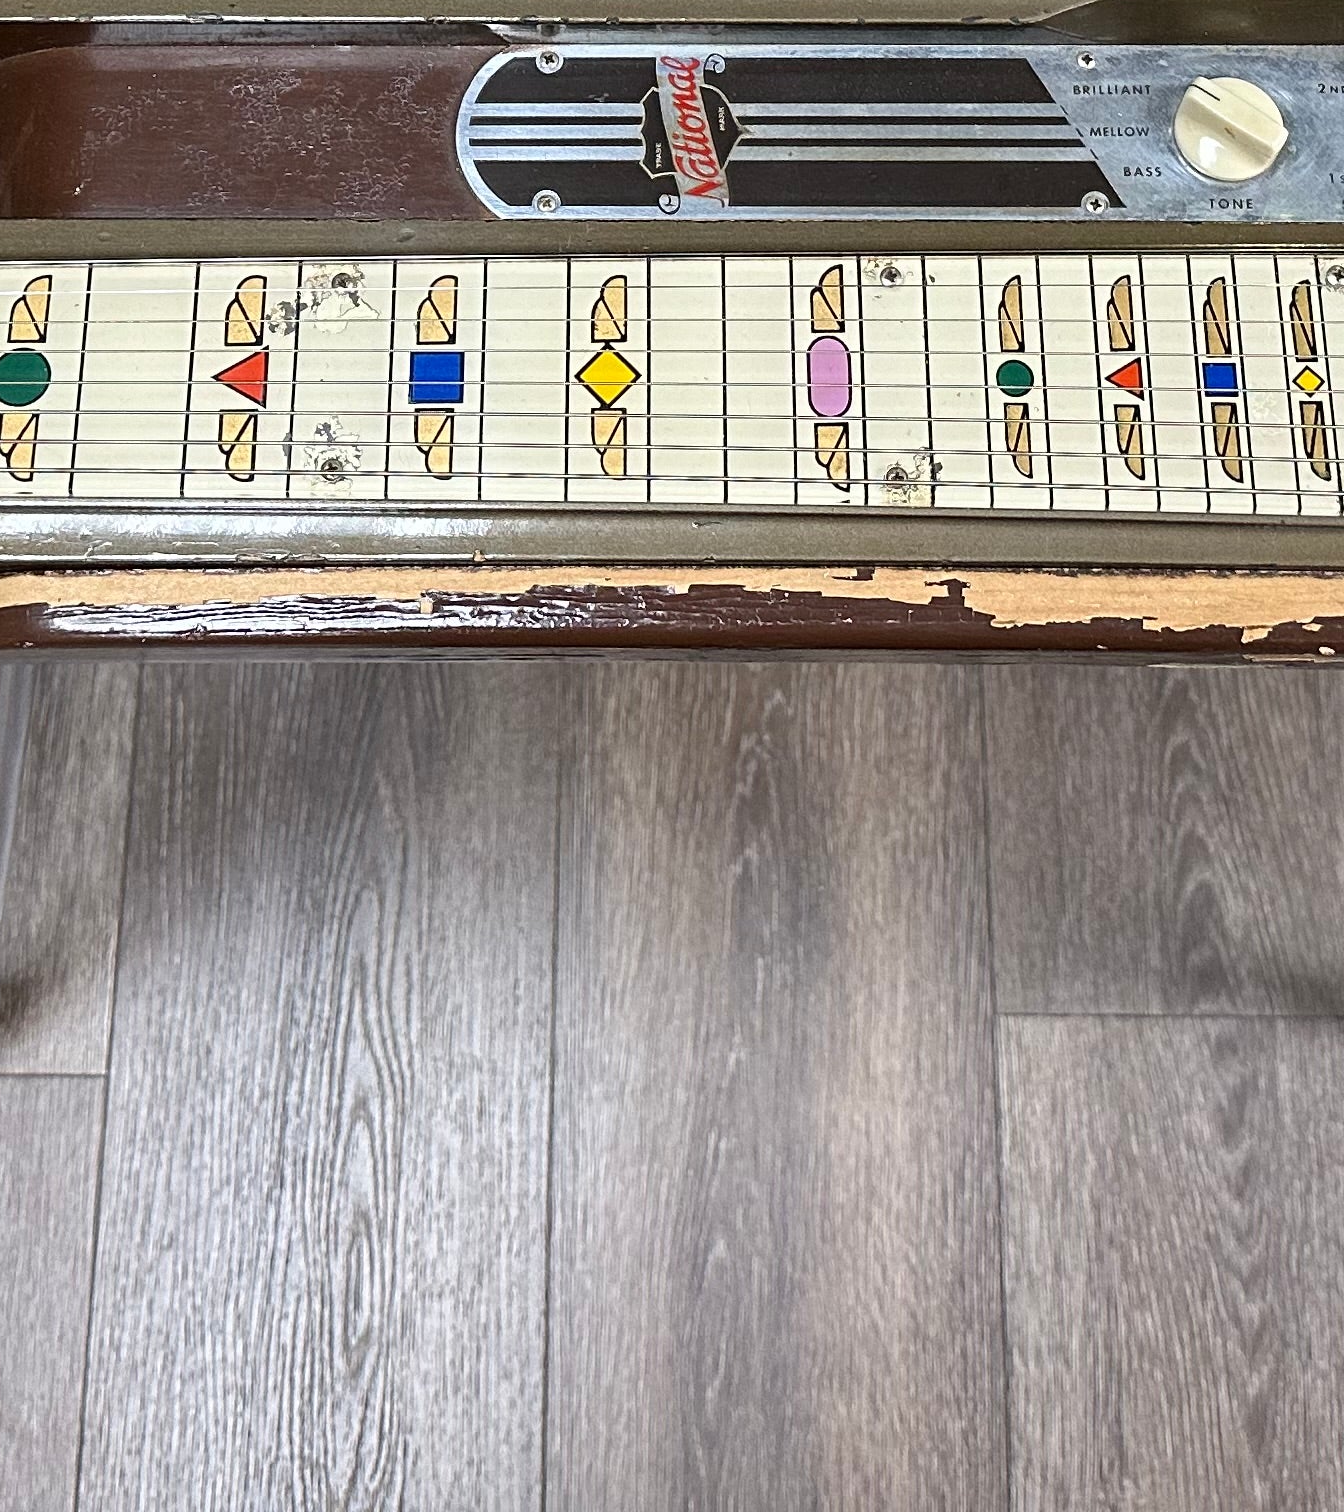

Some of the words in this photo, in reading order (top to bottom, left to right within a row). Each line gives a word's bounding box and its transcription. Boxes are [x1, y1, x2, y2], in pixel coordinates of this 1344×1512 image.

[1073, 84, 1151, 96] BRILLIANT
[660, 55, 725, 208] National
[1089, 126, 1150, 137] MELLOW
[1123, 166, 1163, 178] BASS
[1208, 198, 1255, 210] TONE
